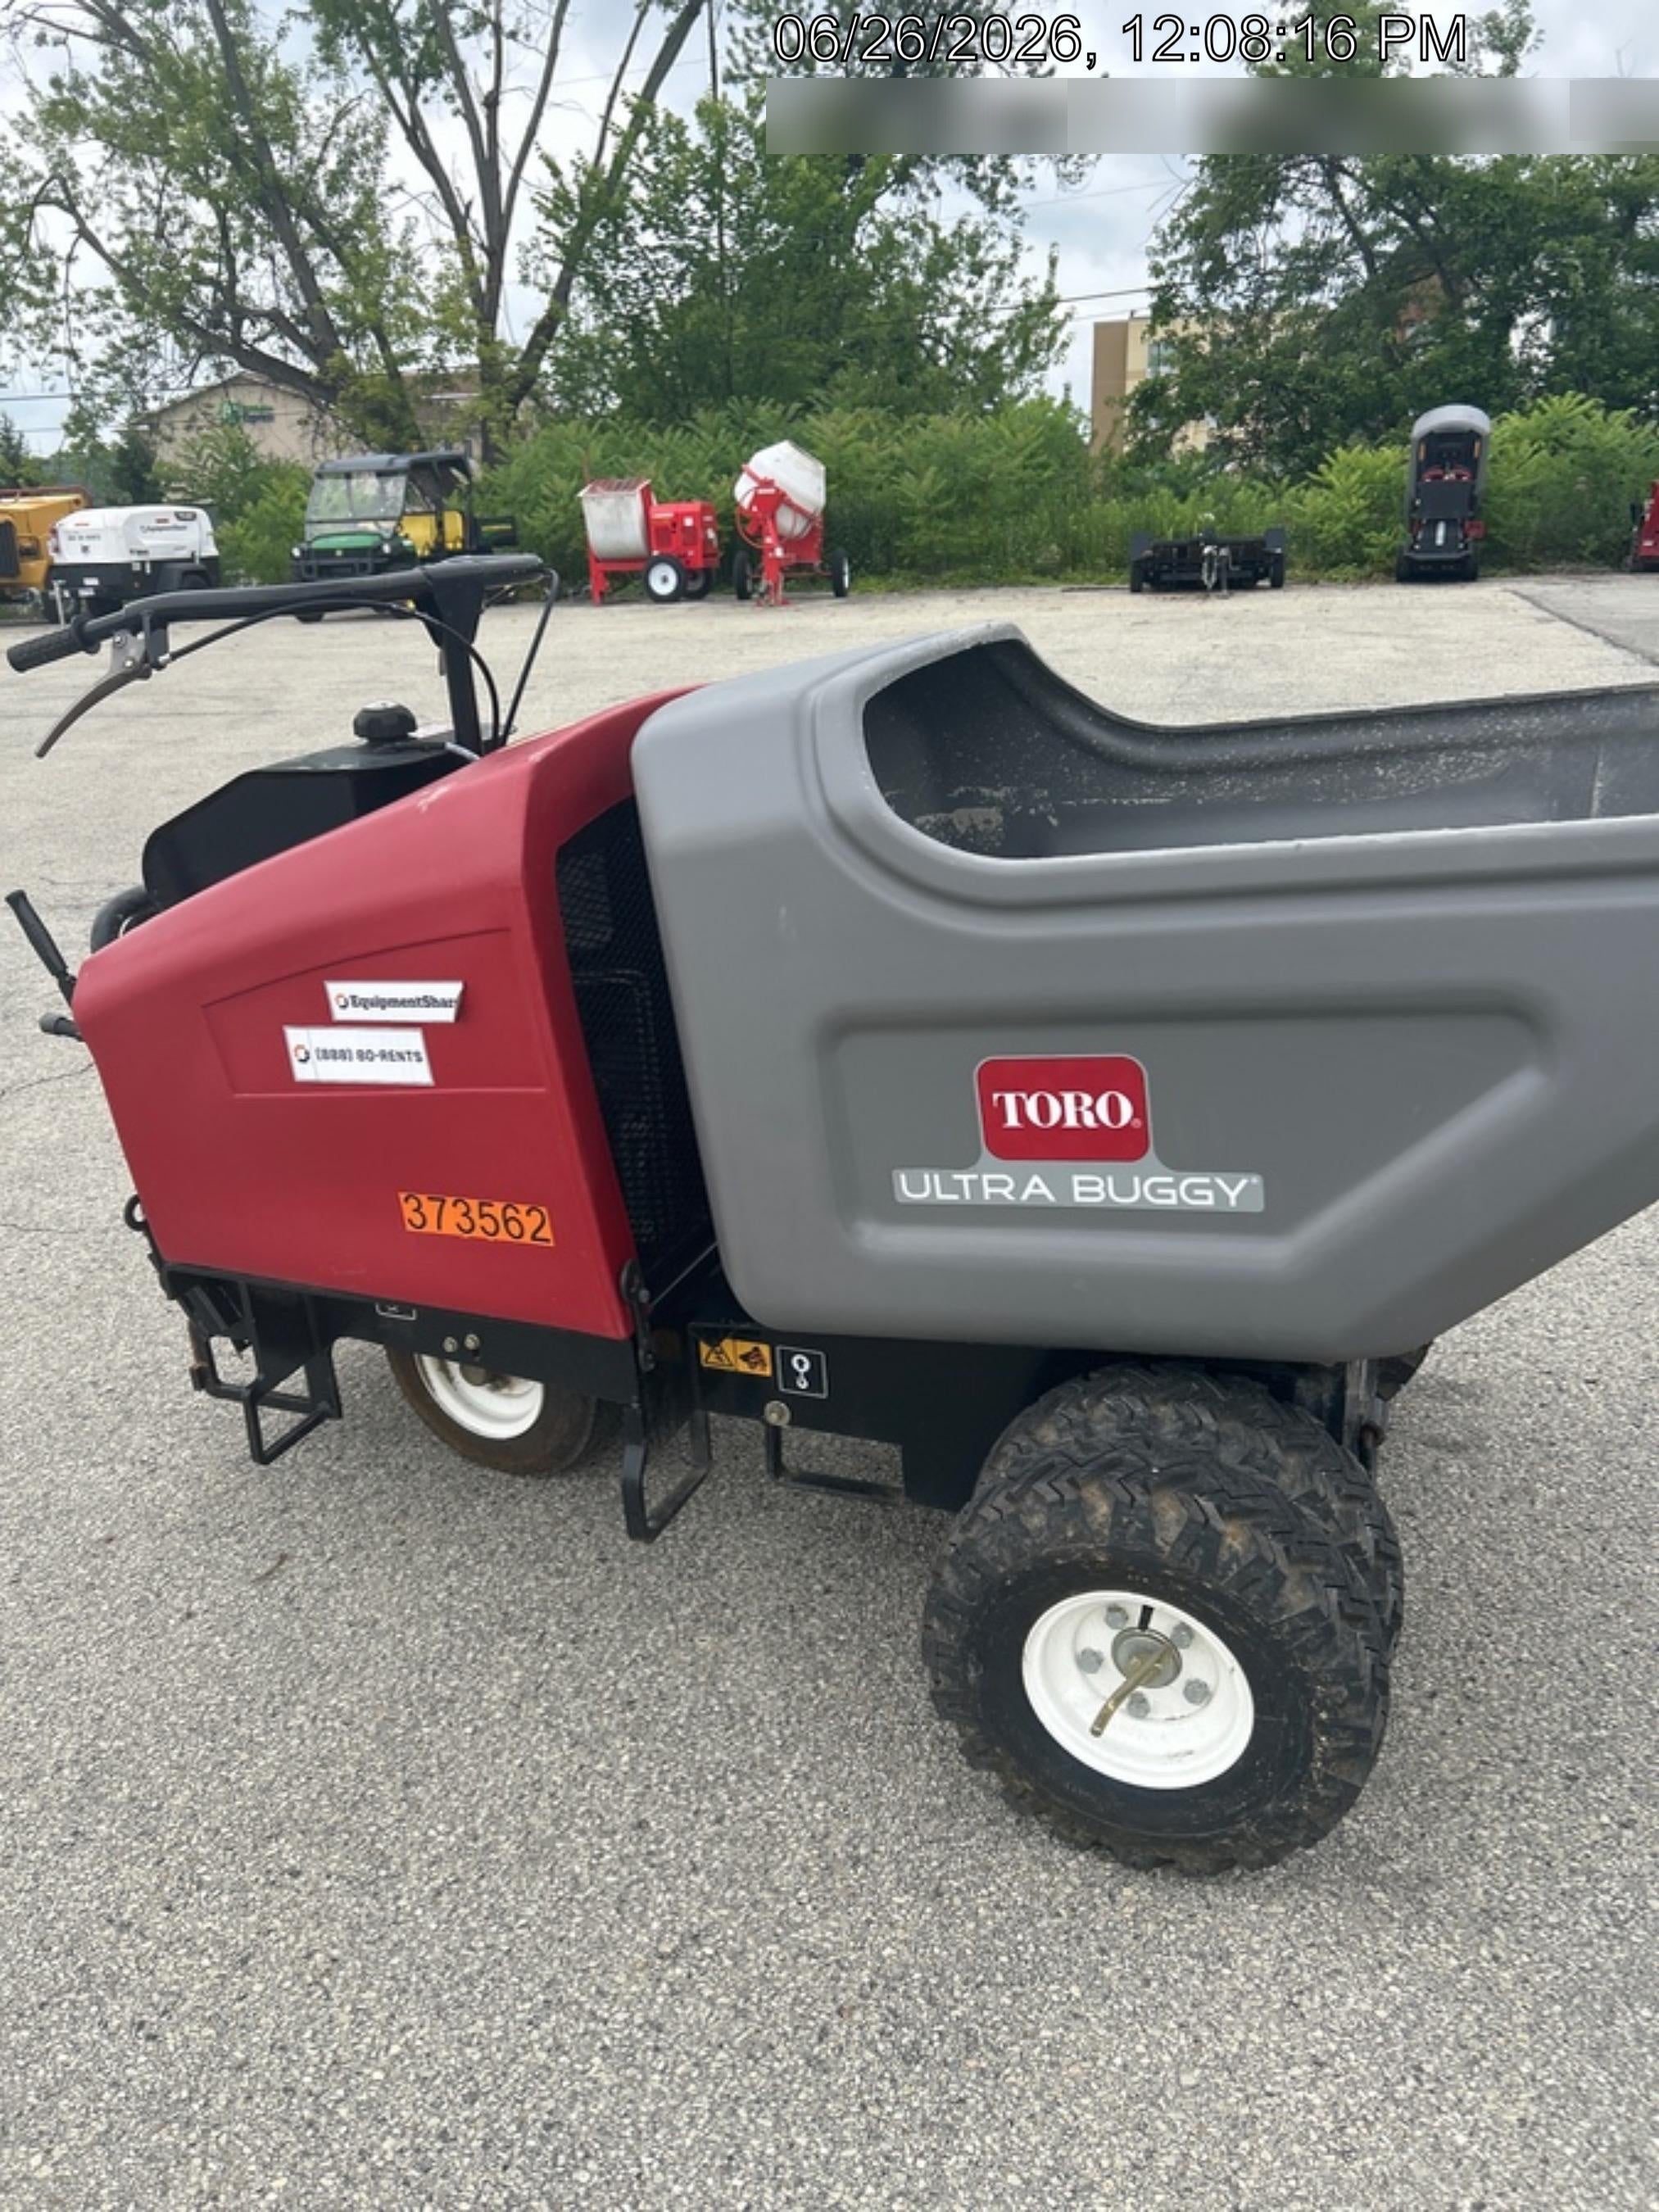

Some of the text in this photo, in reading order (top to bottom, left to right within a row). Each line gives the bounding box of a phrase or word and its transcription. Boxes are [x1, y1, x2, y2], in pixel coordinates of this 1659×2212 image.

[900, 1174, 1247, 1208] ULTRA BUGGY
[404, 1194, 551, 1243] 373562
